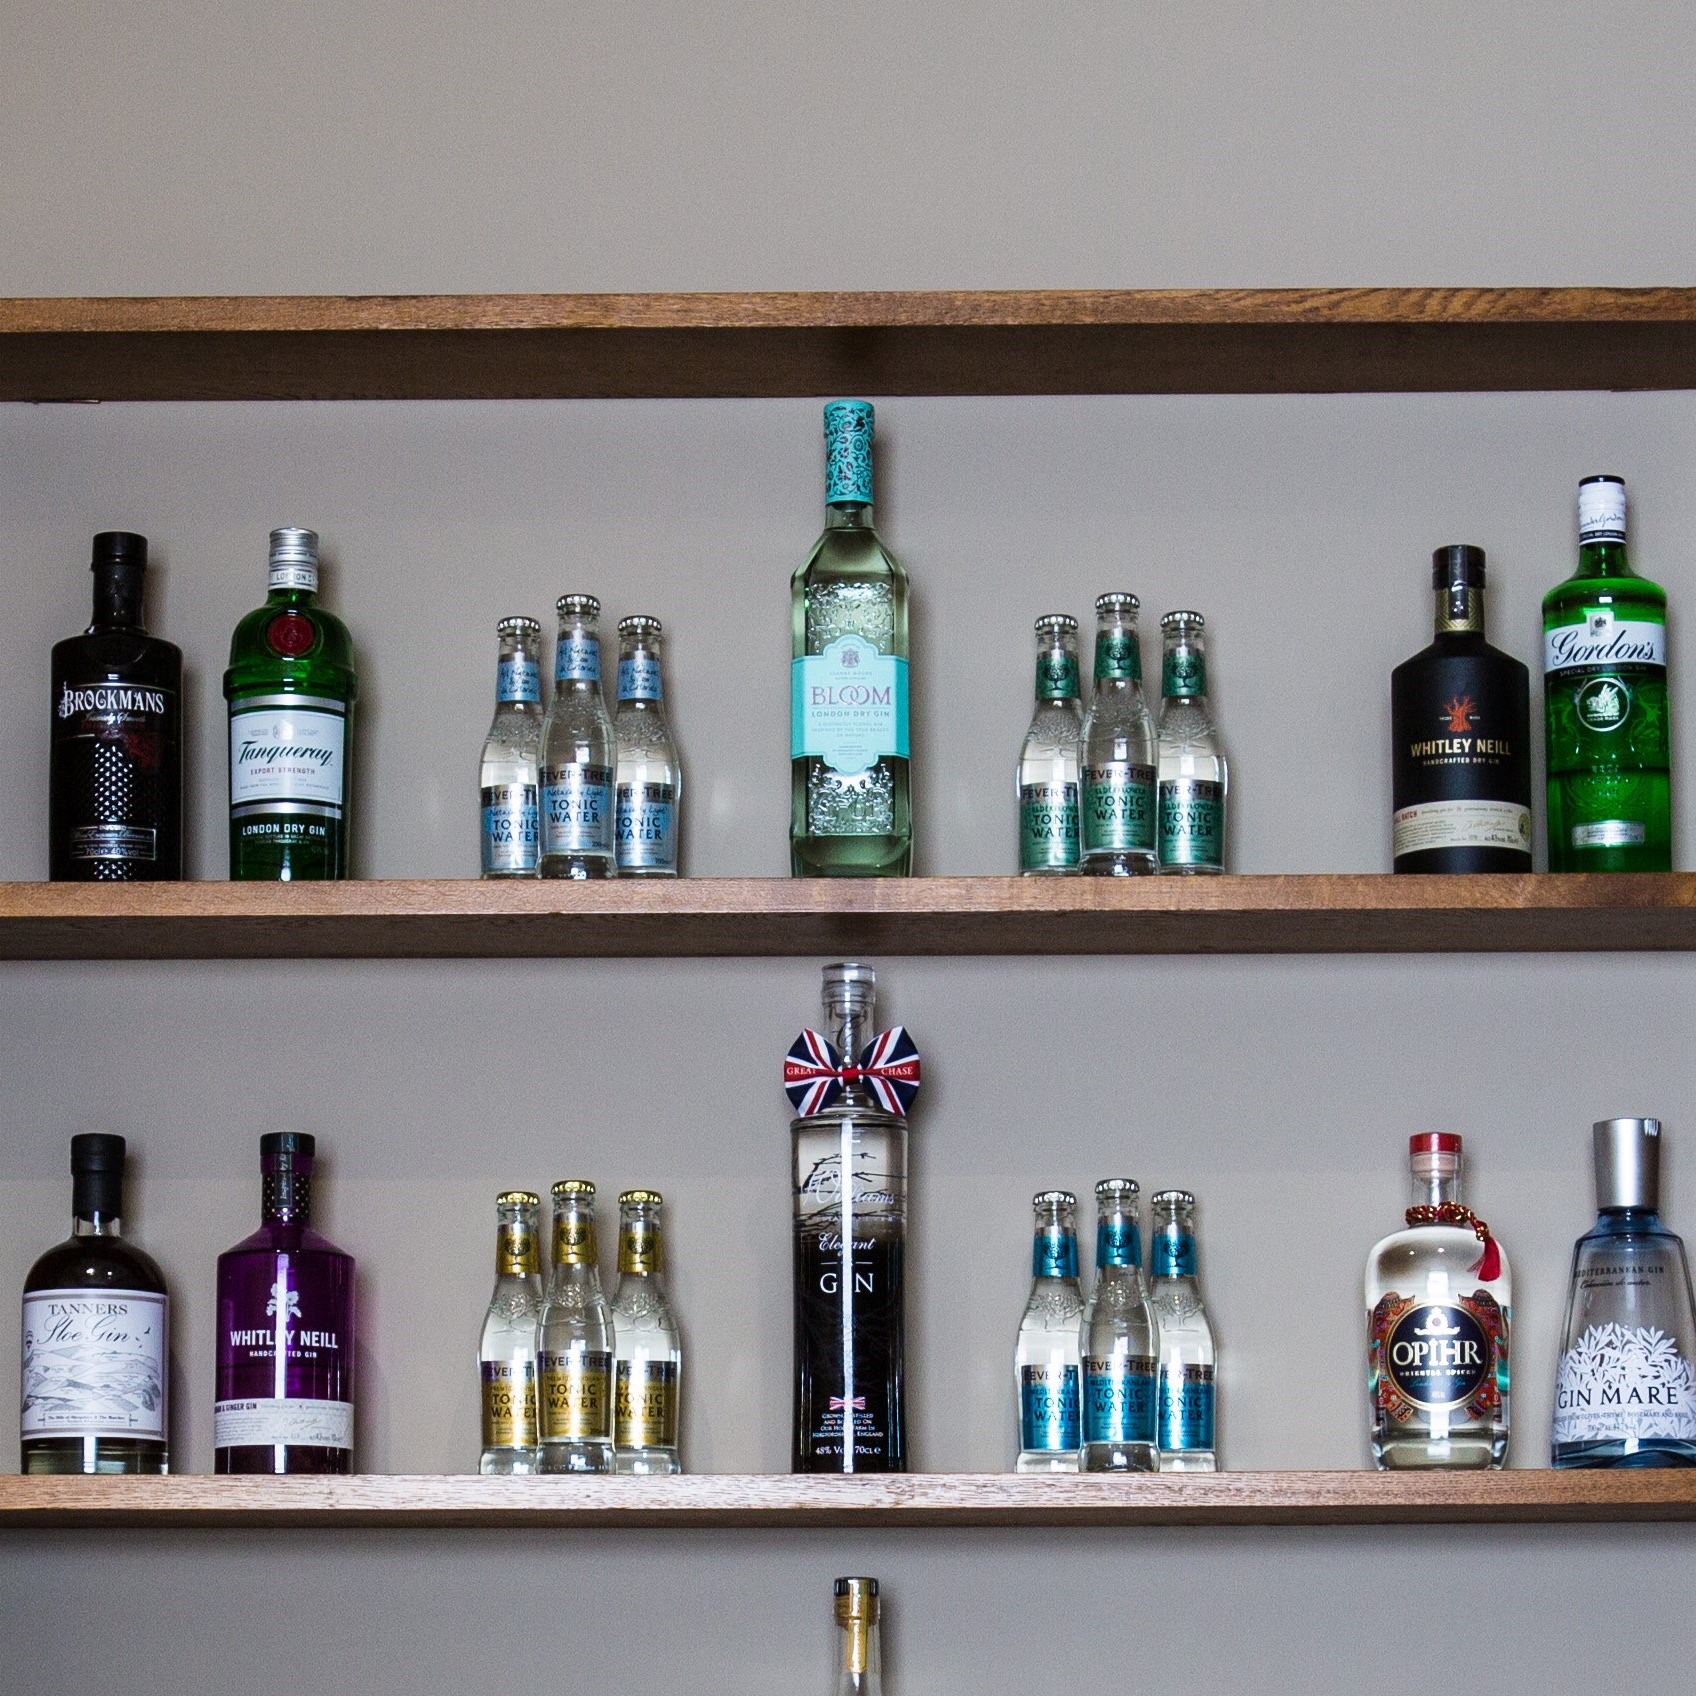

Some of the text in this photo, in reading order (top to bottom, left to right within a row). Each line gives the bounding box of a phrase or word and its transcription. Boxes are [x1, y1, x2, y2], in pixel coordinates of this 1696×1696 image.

[1552, 630, 1654, 666] Gordon's
[1560, 668, 1584, 677] SPECIAL
[811, 685, 891, 706] BLOOM
[60, 688, 164, 718] BROCKMANS
[239, 740, 333, 766] Tanqueray
[1411, 739, 1511, 757] WHITLEY NEILL
[1423, 757, 1470, 765] HANDCRAFTED
[250, 767, 315, 775] EXPORT STRENGTH
[616, 787, 673, 799] VER-TREE
[551, 800, 598, 810] TONIC
[1097, 796, 1143, 807] TONIC
[550, 812, 600, 823] WATER
[1033, 815, 1079, 825] TONIC
[1096, 809, 1144, 820] WATER
[1165, 812, 1211, 823] TONIC
[243, 824, 326, 836] LONDON DRY GIN
[493, 819, 538, 831] TONIC
[1164, 825, 1212, 836] WATER
[1032, 827, 1079, 838] WATER
[787, 1067, 913, 1075] GREAT CHASE
[803, 1169, 895, 1205] Wliams
[820, 1272, 873, 1294] GN
[48, 1304, 128, 1315] TANNERS
[37, 1314, 130, 1344] Sloe Gin
[230, 1330, 338, 1348] WHITLY NEILL
[1392, 1338, 1482, 1366] OPIHR
[1085, 1360, 1156, 1372] FEVE-TREE
[549, 1384, 596, 1395] TONIC
[1095, 1389, 1143, 1399] TONIC
[1558, 1386, 1679, 1409] GIN MARE
[1094, 1402, 1144, 1412] WATER
[1034, 1411, 1079, 1421] WATE
